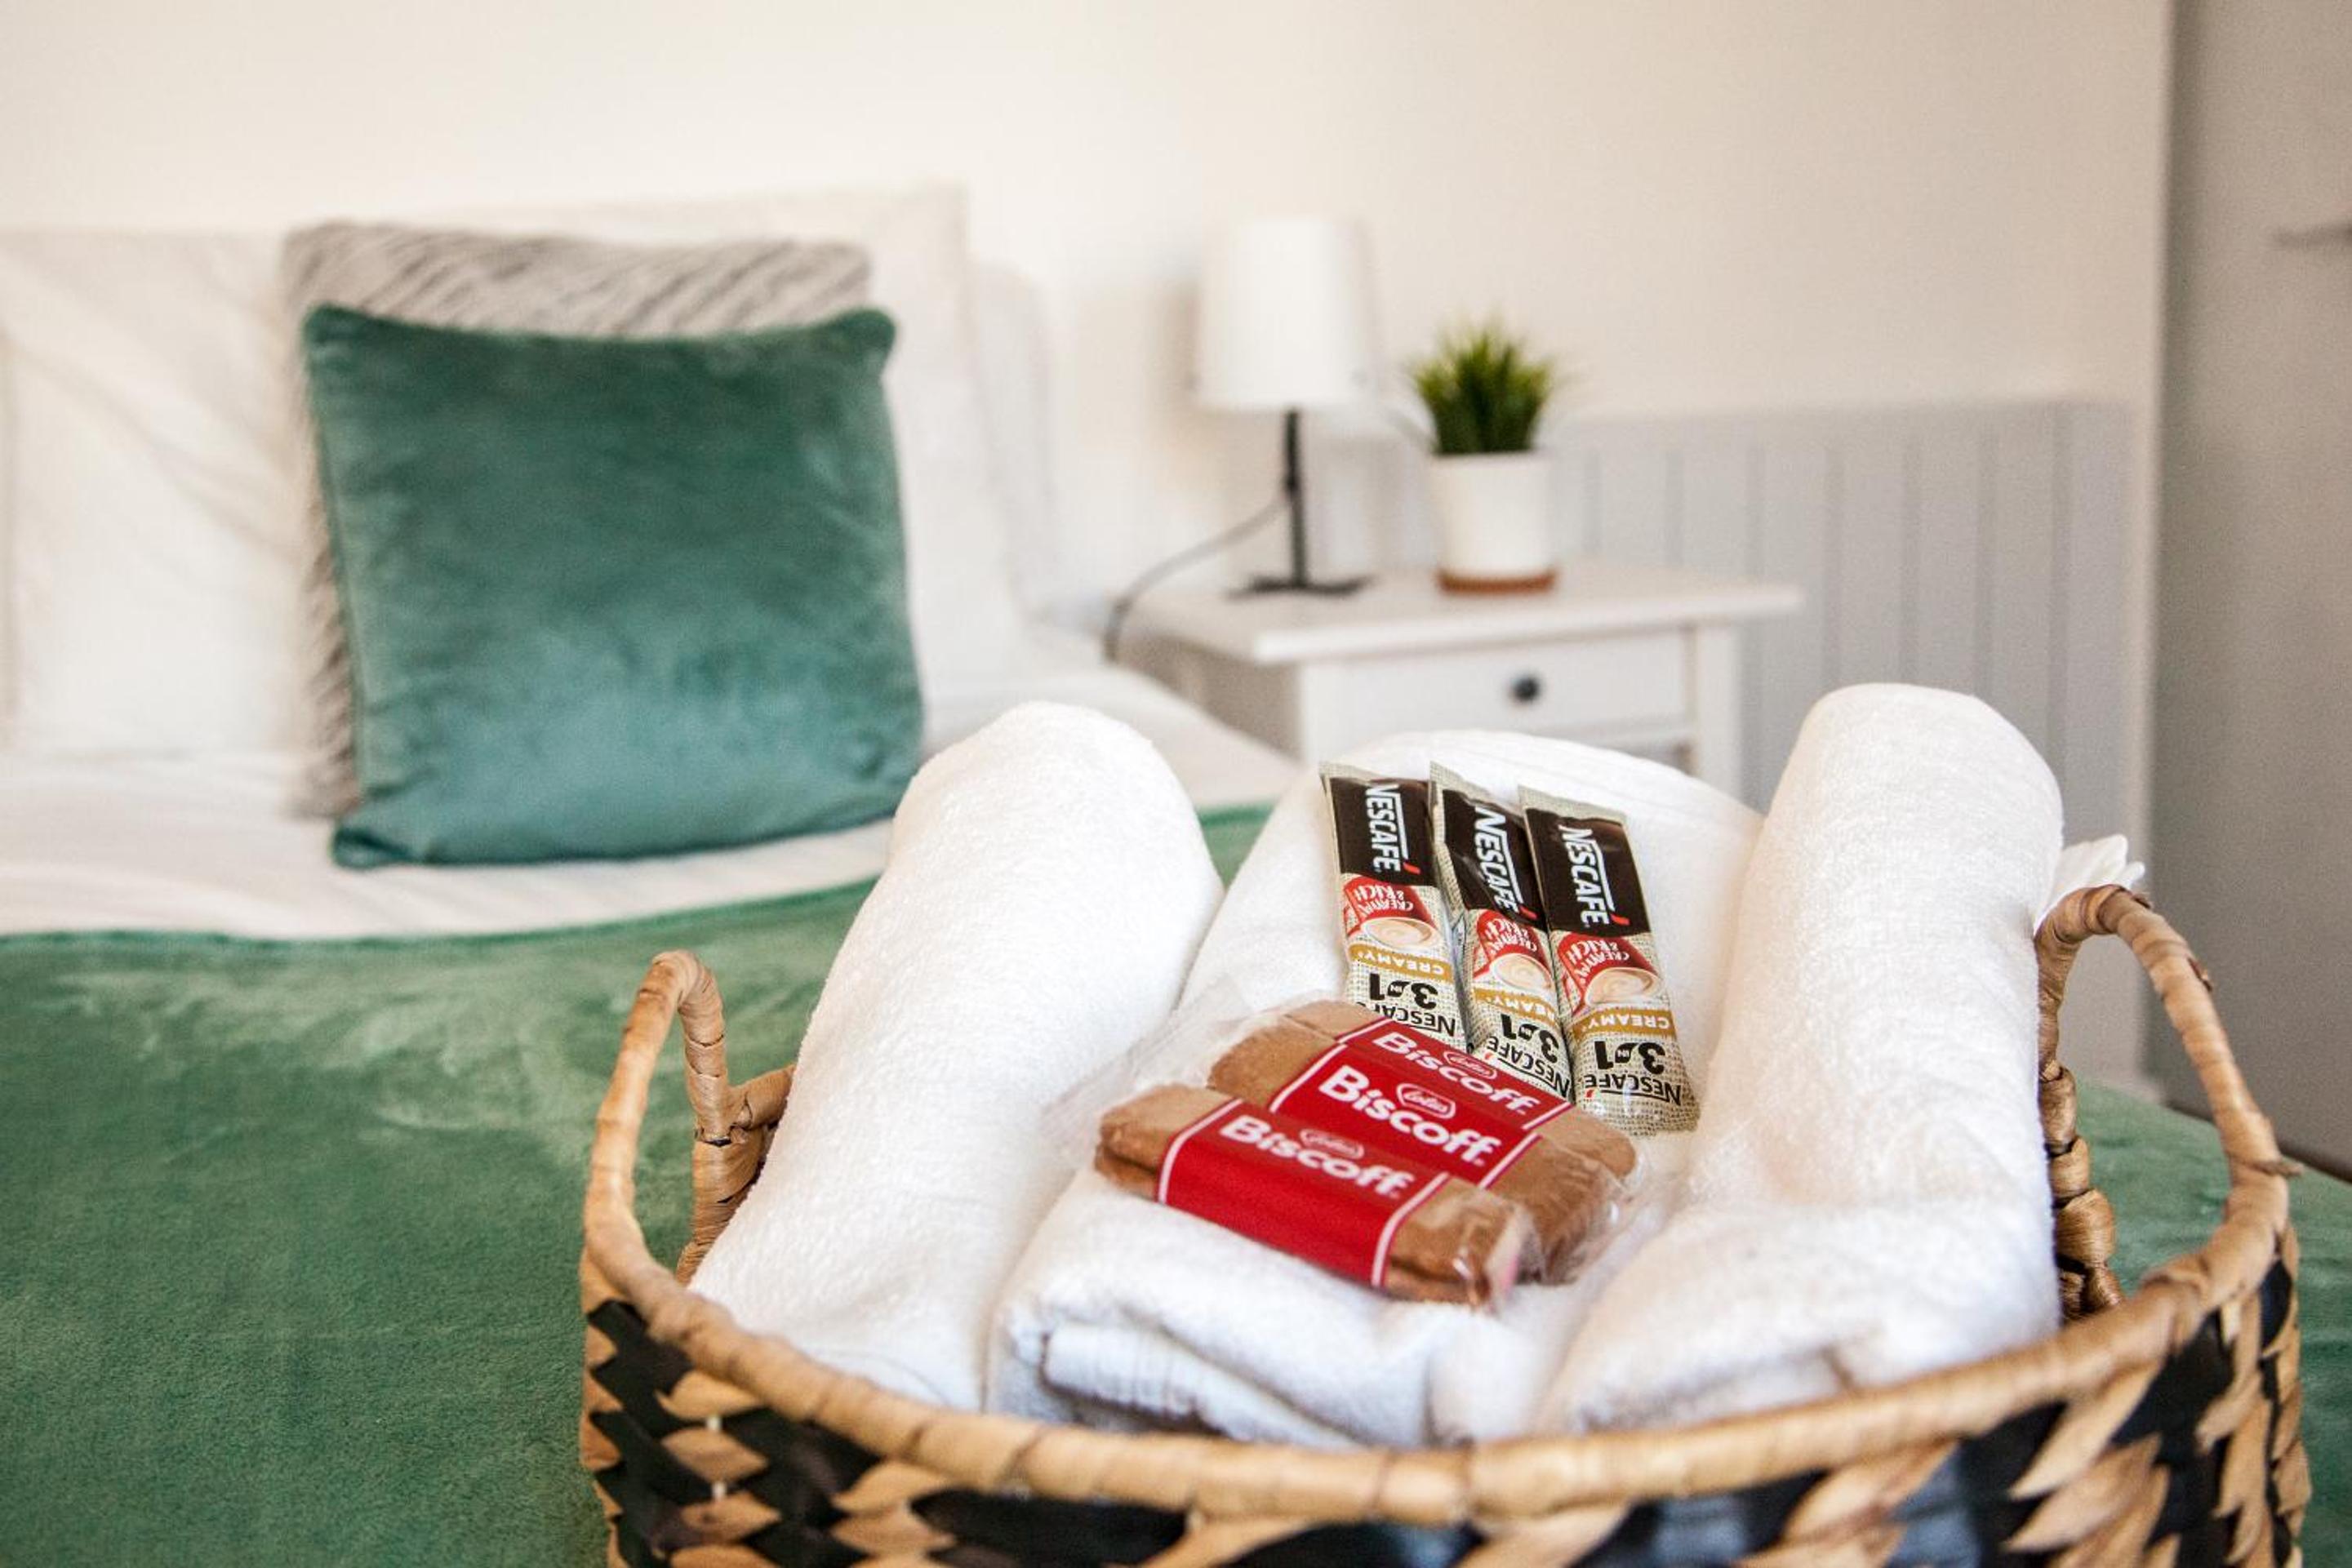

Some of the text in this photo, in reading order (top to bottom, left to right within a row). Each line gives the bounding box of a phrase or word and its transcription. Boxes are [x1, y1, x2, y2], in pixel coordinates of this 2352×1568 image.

[1357, 1002, 1456, 1037] NESCA
[1372, 1032, 1540, 1113] Biscoff
[1219, 1114, 1415, 1197] Biscoff
[1318, 1064, 1502, 1165] Biscoff
